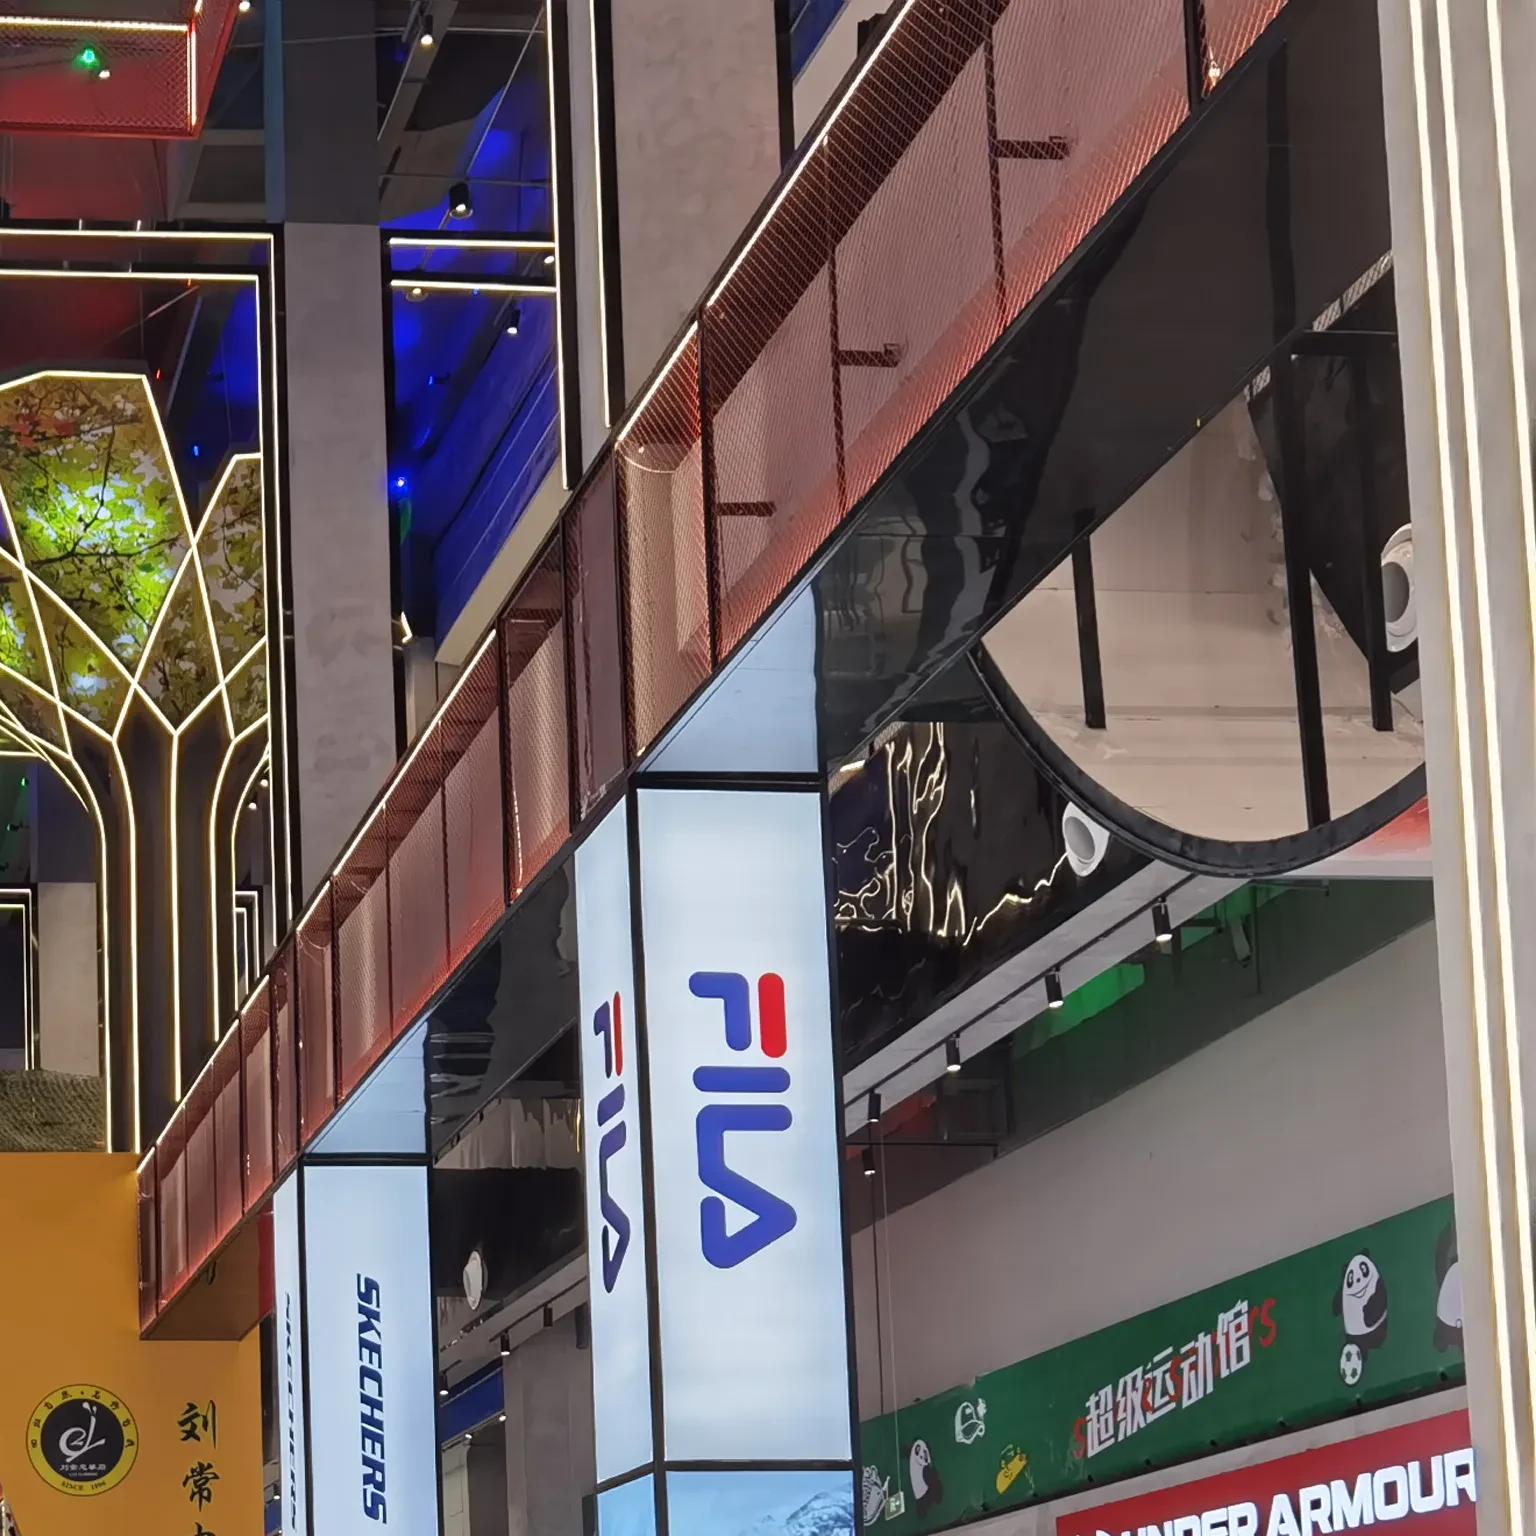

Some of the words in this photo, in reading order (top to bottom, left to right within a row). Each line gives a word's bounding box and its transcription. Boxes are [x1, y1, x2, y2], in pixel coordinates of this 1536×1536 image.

[594, 991, 631, 1293] FILA
[689, 971, 797, 1269] FILA
[357, 1273, 387, 1525] SKECHERS
[1085, 1299, 1251, 1459] 超级运动馆
